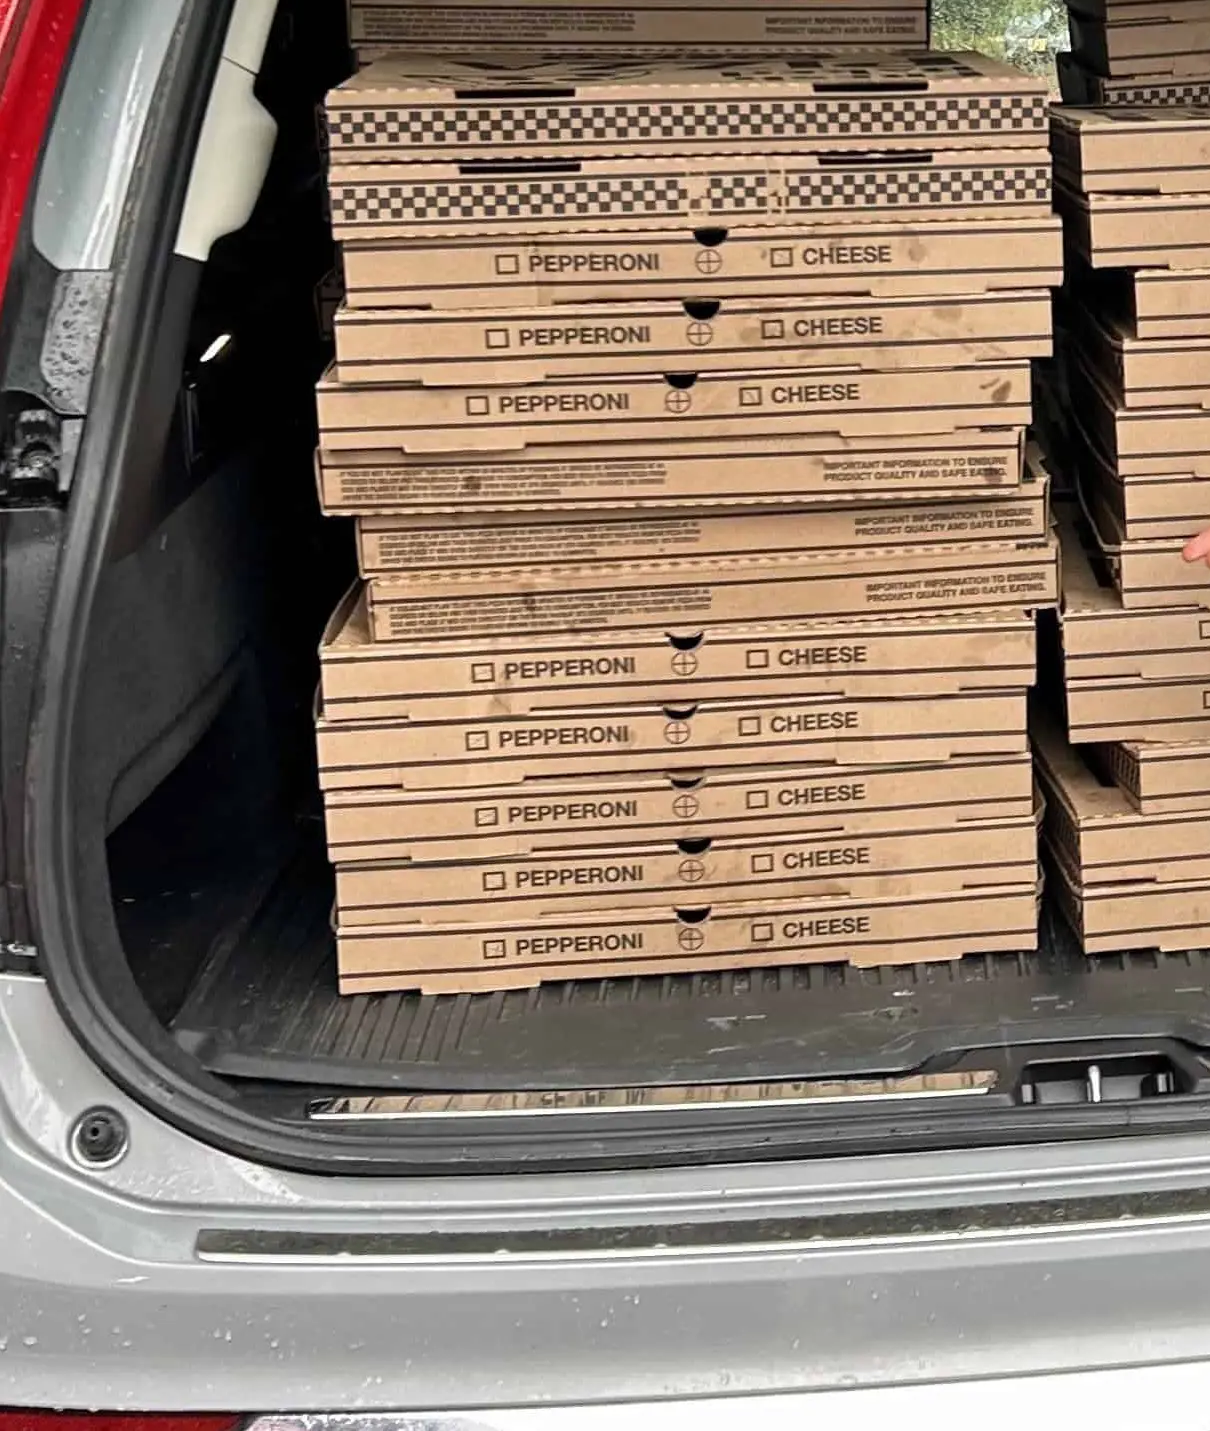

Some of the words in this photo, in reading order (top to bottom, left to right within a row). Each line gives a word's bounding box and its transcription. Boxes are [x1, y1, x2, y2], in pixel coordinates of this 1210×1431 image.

[528, 251, 660, 273] PEPPERONI
[802, 244, 892, 267] CHEESE
[518, 324, 651, 347] PEPPERONI
[793, 316, 883, 338] CHEESE
[498, 390, 630, 414] PEPPERONI
[770, 382, 860, 405] CHEESE
[874, 470, 916, 480] QUALITY
[919, 469, 940, 478] AND
[942, 468, 968, 478] SAFE
[953, 457, 966, 466] TO
[855, 526, 902, 536] PRODUCT
[904, 524, 945, 534] QUALITY
[947, 522, 968, 531] AND
[970, 521, 994, 530] SAFE
[980, 510, 993, 518] TO
[866, 580, 922, 592] IMPORTANT
[991, 574, 1005, 582] TO
[866, 593, 913, 602] PRODUCT
[915, 589, 958, 600] QUALITY
[959, 588, 979, 596] AND
[981, 585, 1006, 595] SAFE
[504, 656, 637, 680] PEPPERONI
[778, 646, 868, 668] CHEESE
[498, 724, 629, 747] PEPPERONI
[769, 710, 858, 734] CHEESE
[507, 799, 638, 823] PEPPERONI
[777, 784, 866, 807] CHEESE
[515, 864, 644, 888] PEPPERONI
[781, 847, 870, 870] CHEESE
[515, 932, 644, 957] PEPPERONI
[781, 916, 870, 939] CHEESE
